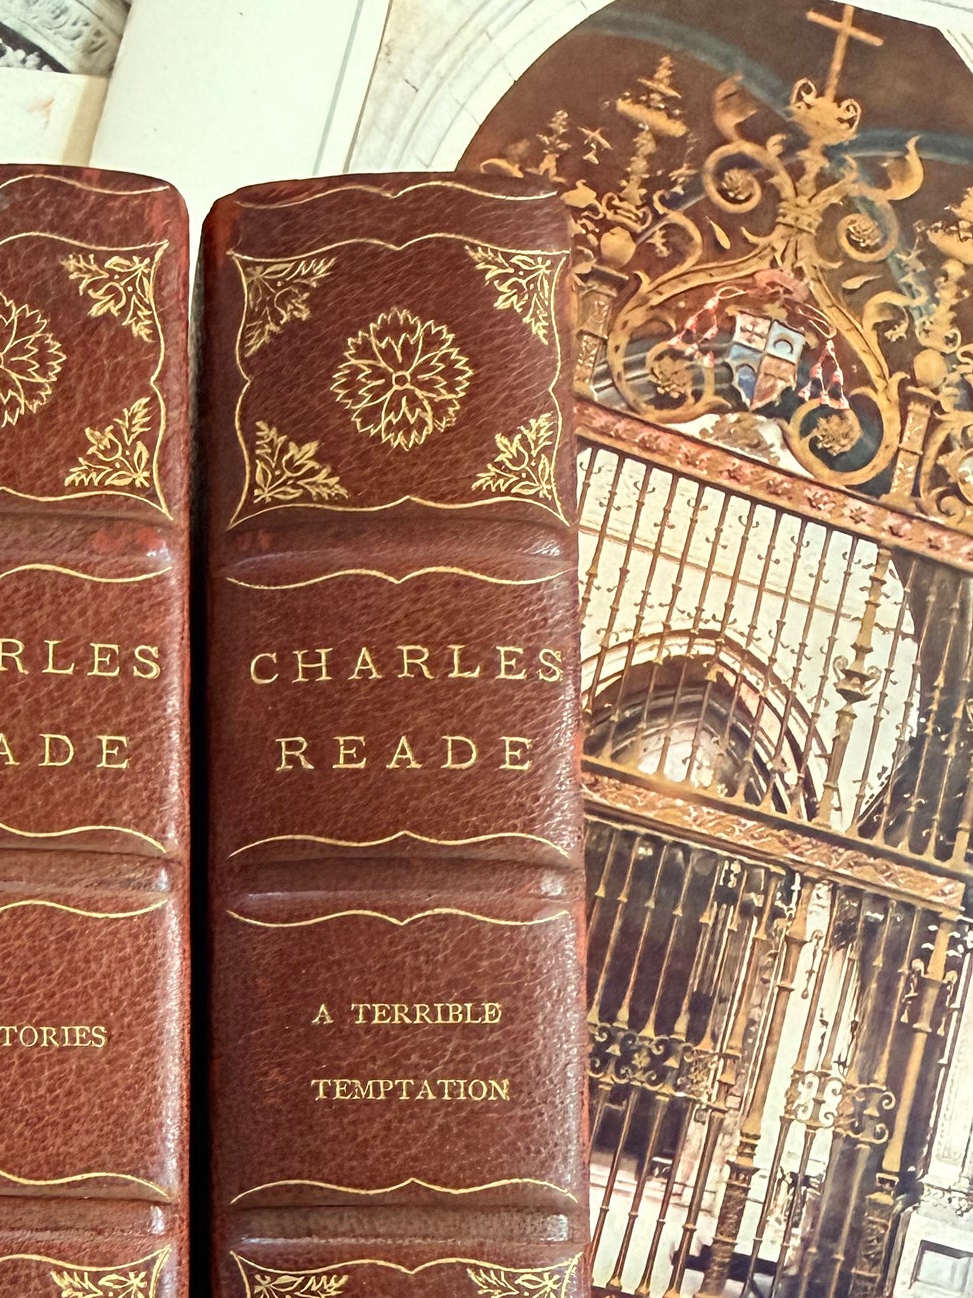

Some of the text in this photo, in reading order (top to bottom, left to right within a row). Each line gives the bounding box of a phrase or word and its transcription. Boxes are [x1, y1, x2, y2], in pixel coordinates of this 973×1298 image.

[249, 644, 564, 685] CHARLES
[275, 735, 534, 772] READE
[312, 1002, 502, 1025] A TERRIBLE
[311, 1078, 510, 1101] TEMPTATION
